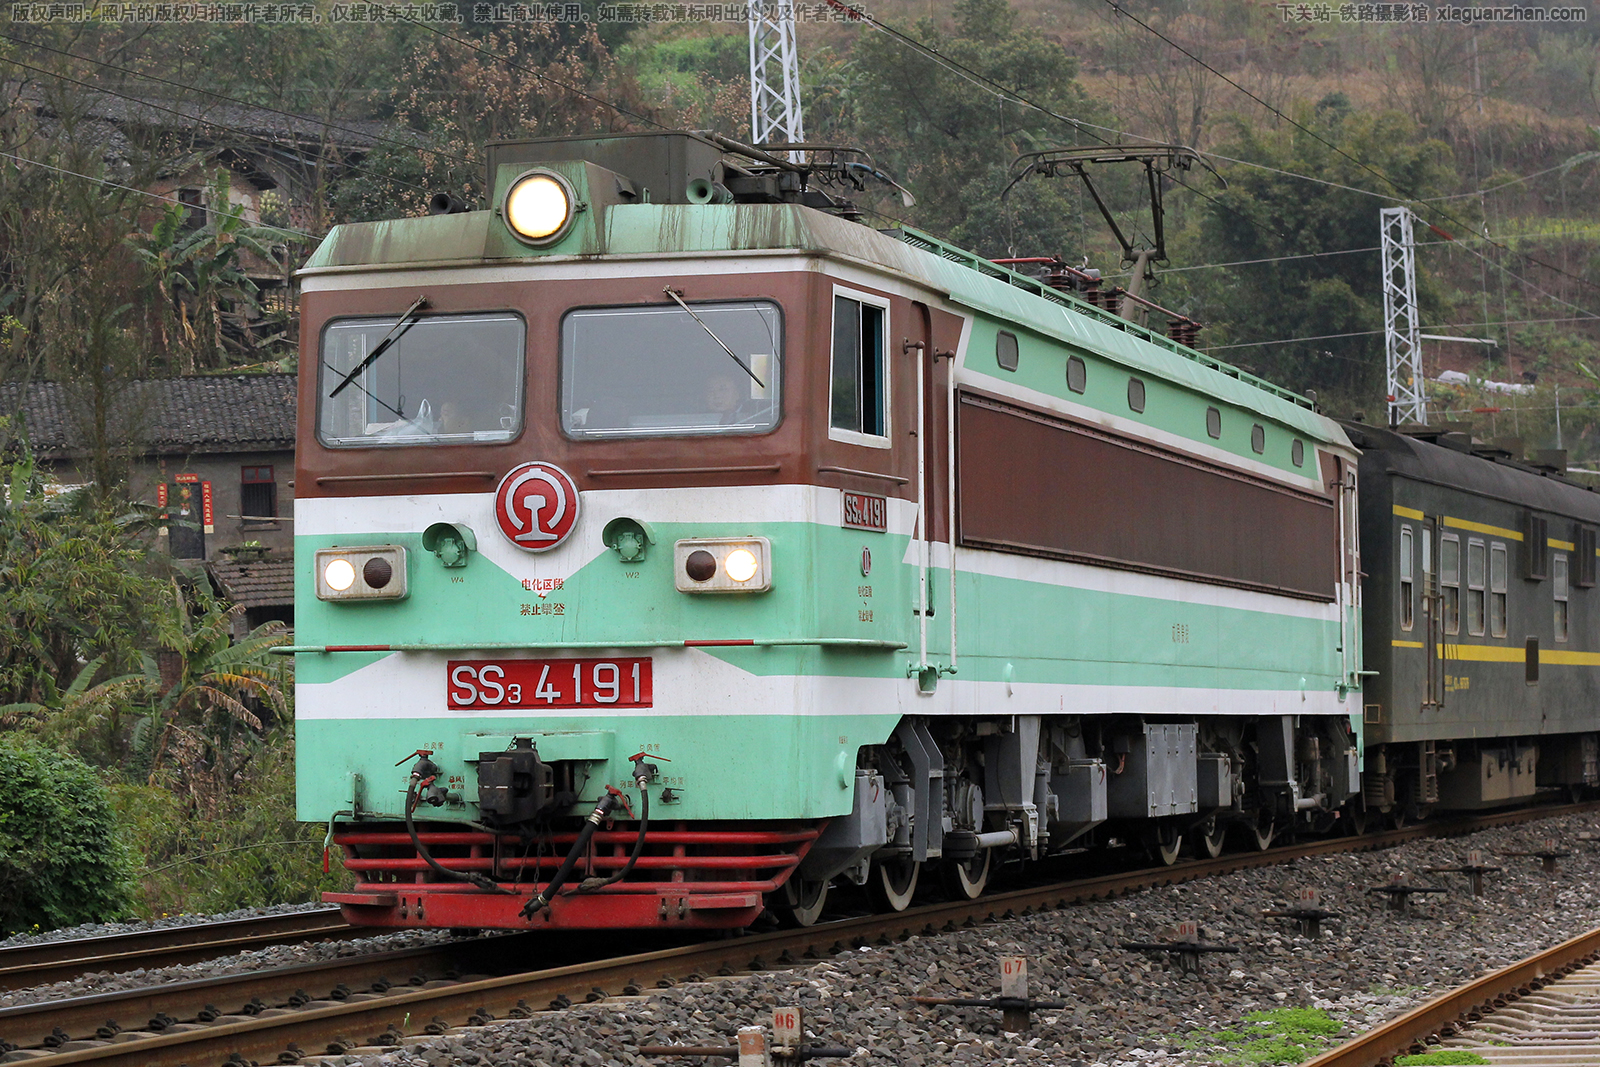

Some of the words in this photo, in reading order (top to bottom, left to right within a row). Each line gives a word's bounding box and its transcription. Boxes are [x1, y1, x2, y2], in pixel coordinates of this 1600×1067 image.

[625, 571, 640, 579] W2
[521, 578, 564, 591] 电化区段
[535, 662, 641, 704] 4191
[1004, 960, 1022, 974] 07
[775, 1013, 795, 1029] 06
